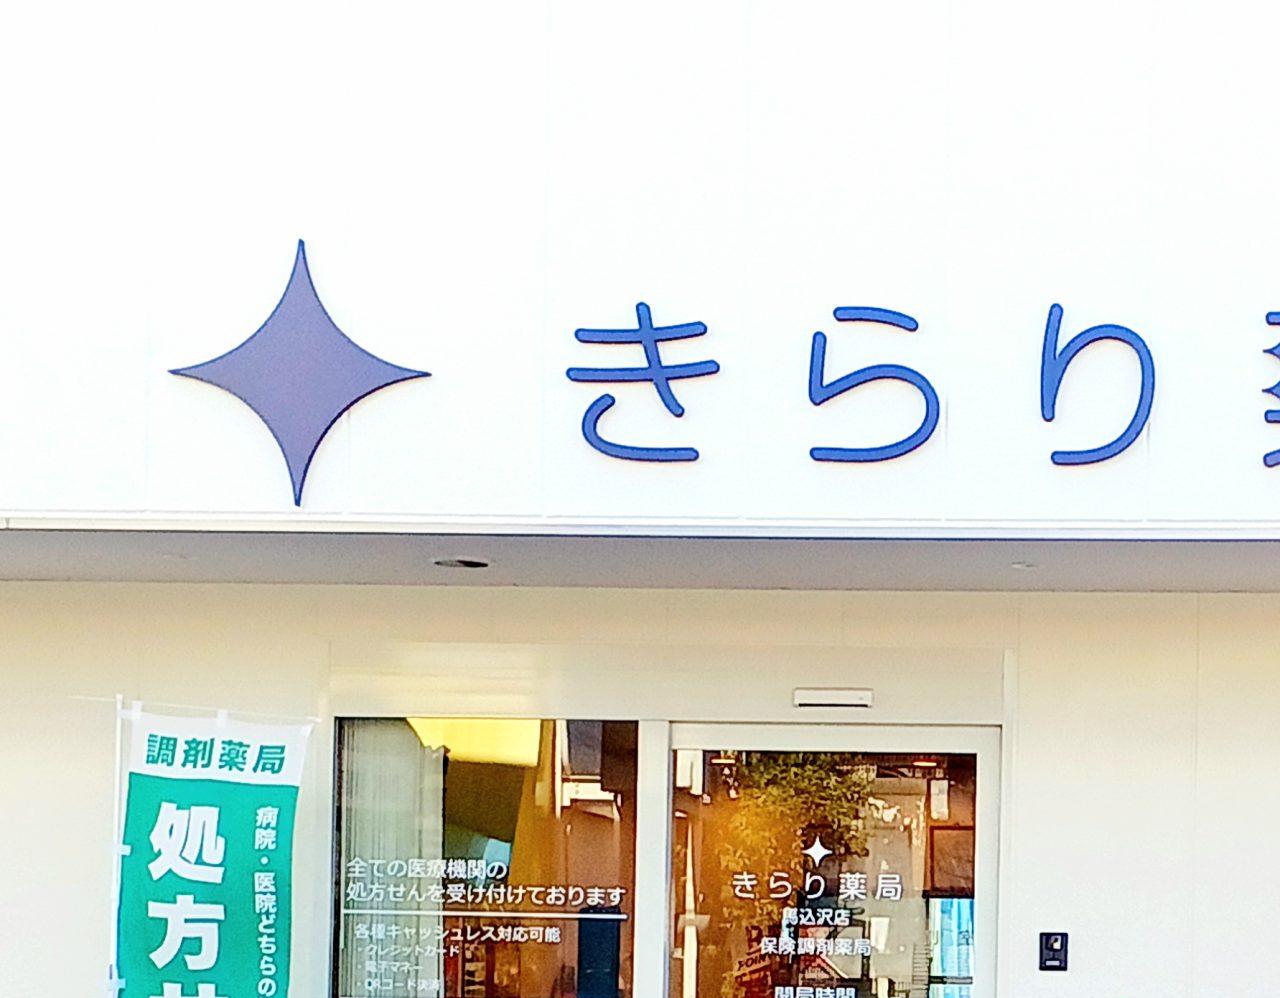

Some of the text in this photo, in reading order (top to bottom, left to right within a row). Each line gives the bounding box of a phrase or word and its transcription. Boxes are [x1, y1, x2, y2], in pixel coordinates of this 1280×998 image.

[145, 733, 286, 775] 調剤薬局
[346, 858, 508, 880] 全ての医療機関の
[346, 882, 627, 906] 処方せんを受け付けております
[732, 871, 903, 901] きらり薬局
[782, 908, 851, 927] 馬込沢店
[354, 923, 561, 944] 各種キャッシュレス対応可能
[760, 937, 872, 957] 保険調剤薬局
